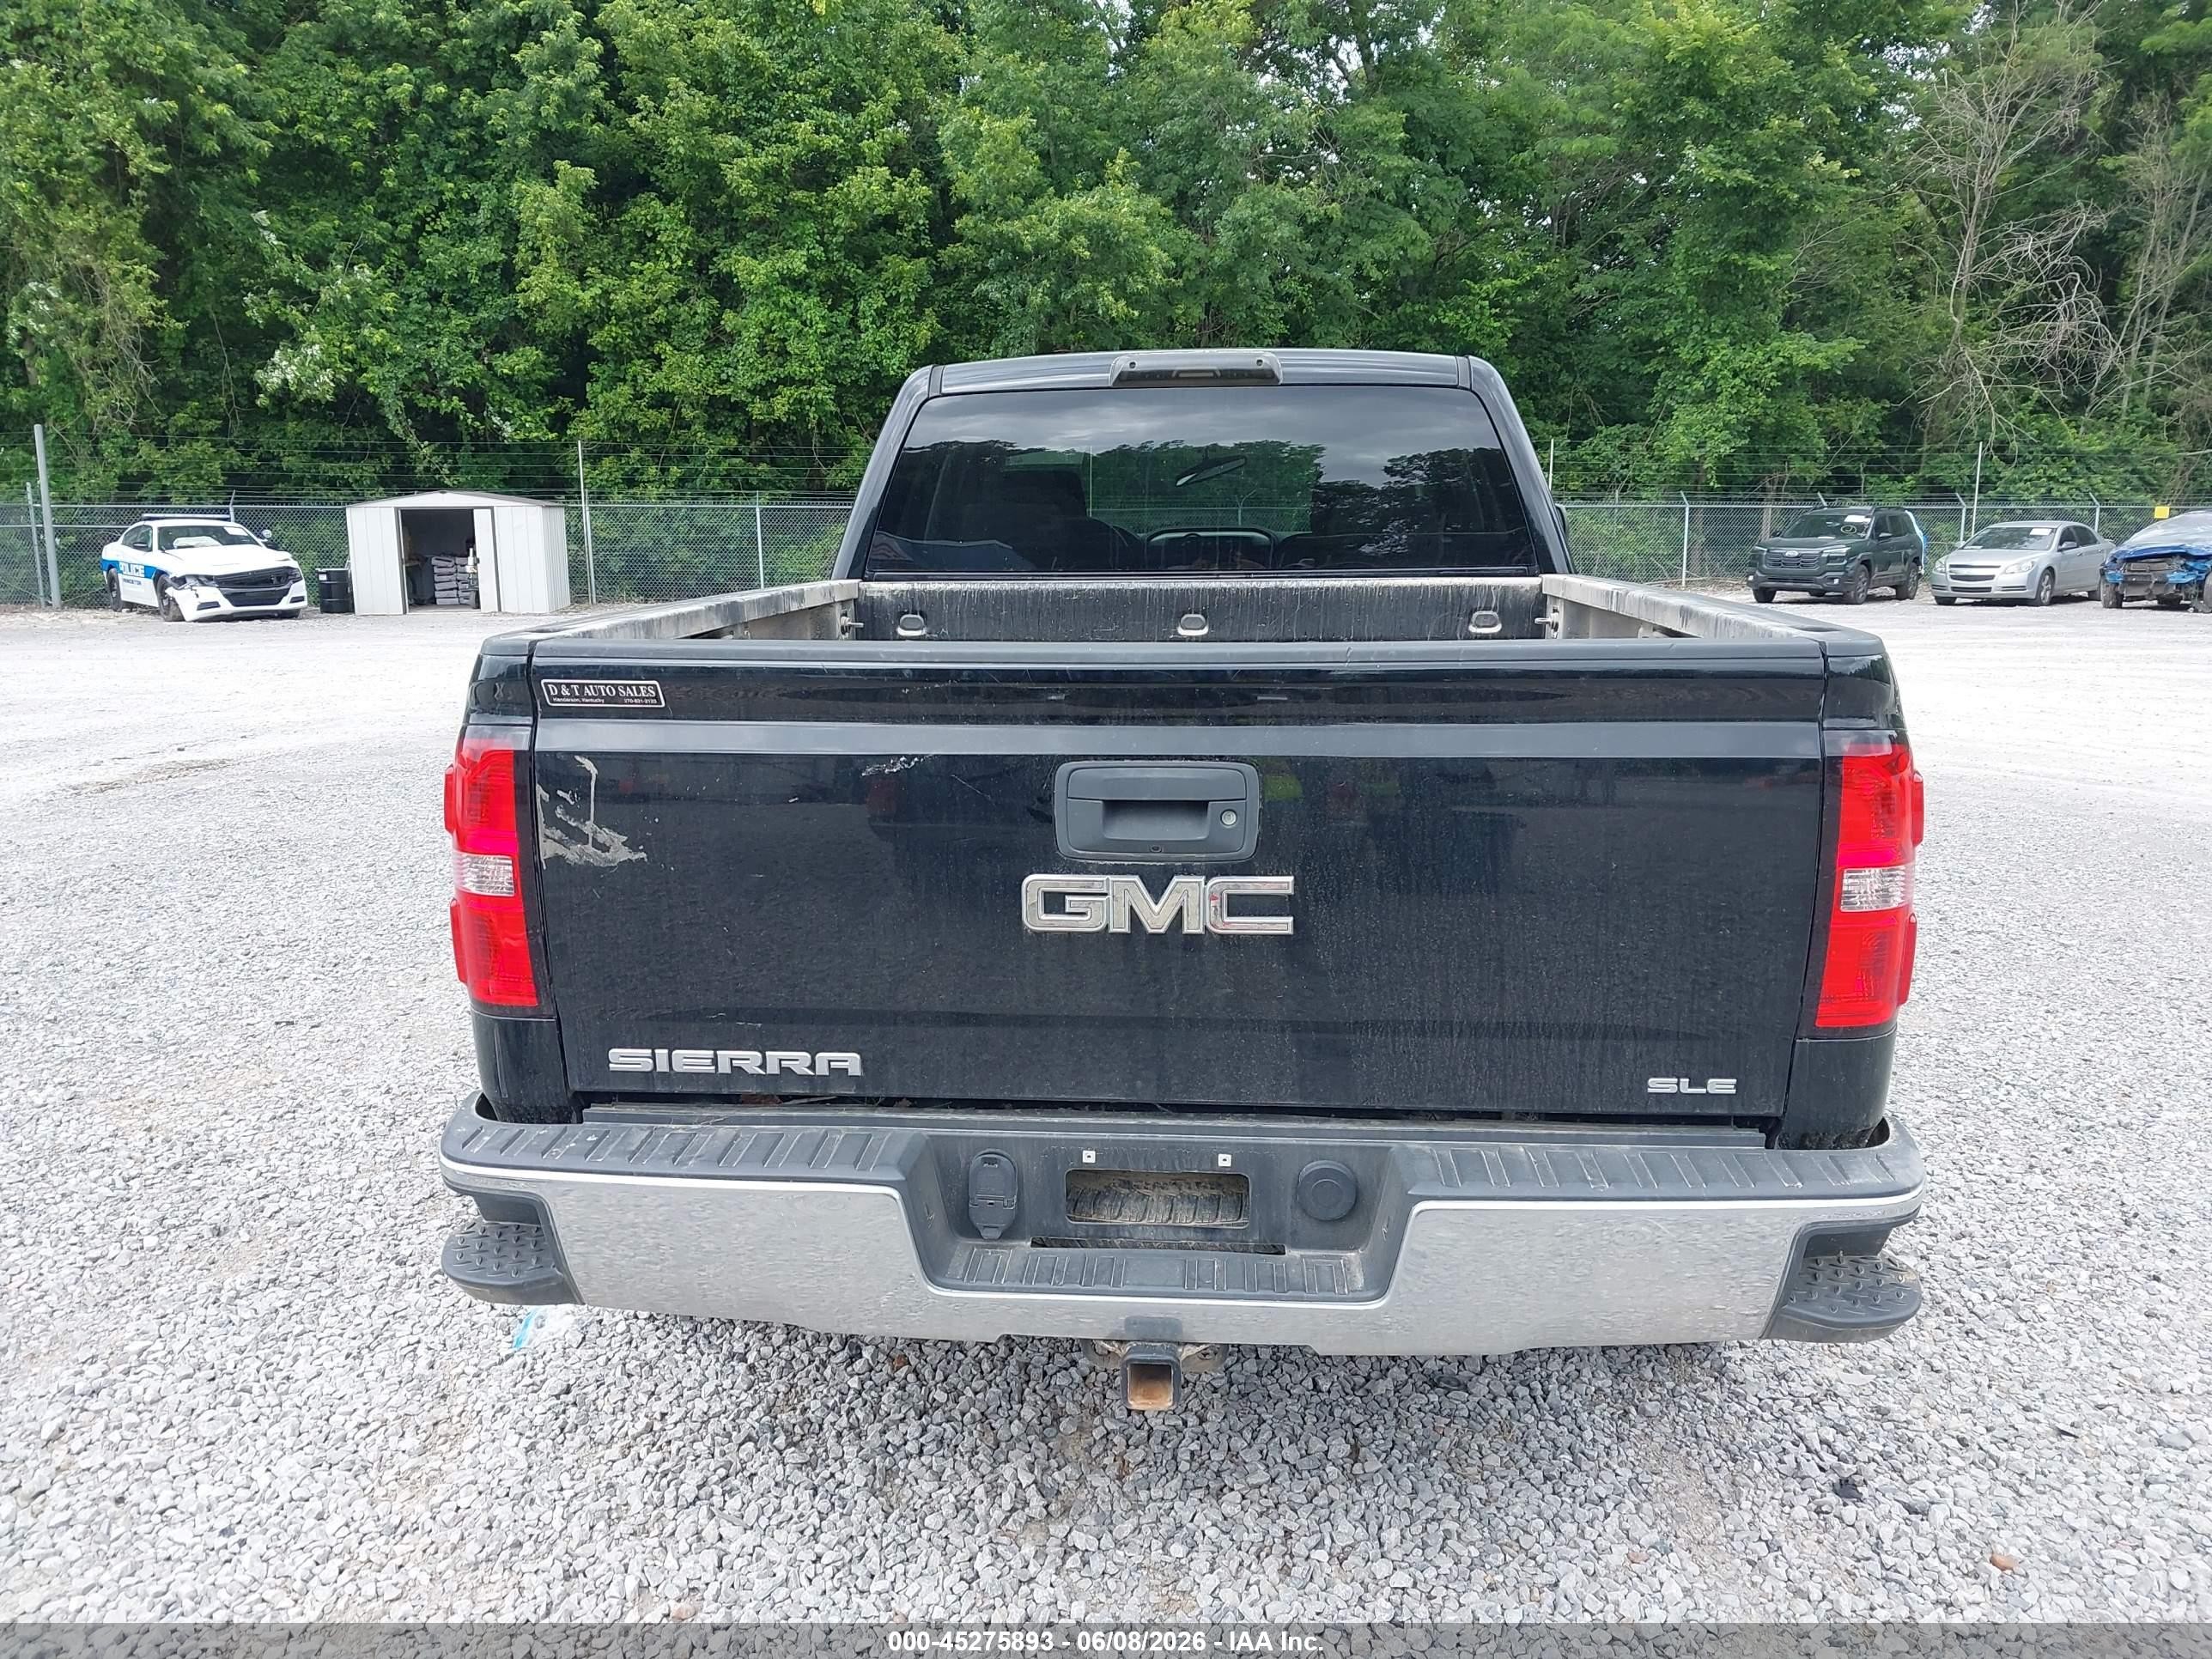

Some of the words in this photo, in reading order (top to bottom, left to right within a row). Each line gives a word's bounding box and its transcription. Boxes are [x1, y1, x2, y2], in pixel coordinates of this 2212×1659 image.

[118, 561, 145, 578] POLICE
[548, 684, 558, 696] D
[561, 685, 571, 696] &
[570, 685, 580, 696] T
[584, 685, 616, 696] AUTO
[618, 686, 656, 697] SALES
[1021, 873, 1294, 934] GMC
[608, 1048, 862, 1076] SIERRA
[1647, 1078, 1737, 1094] SLE
